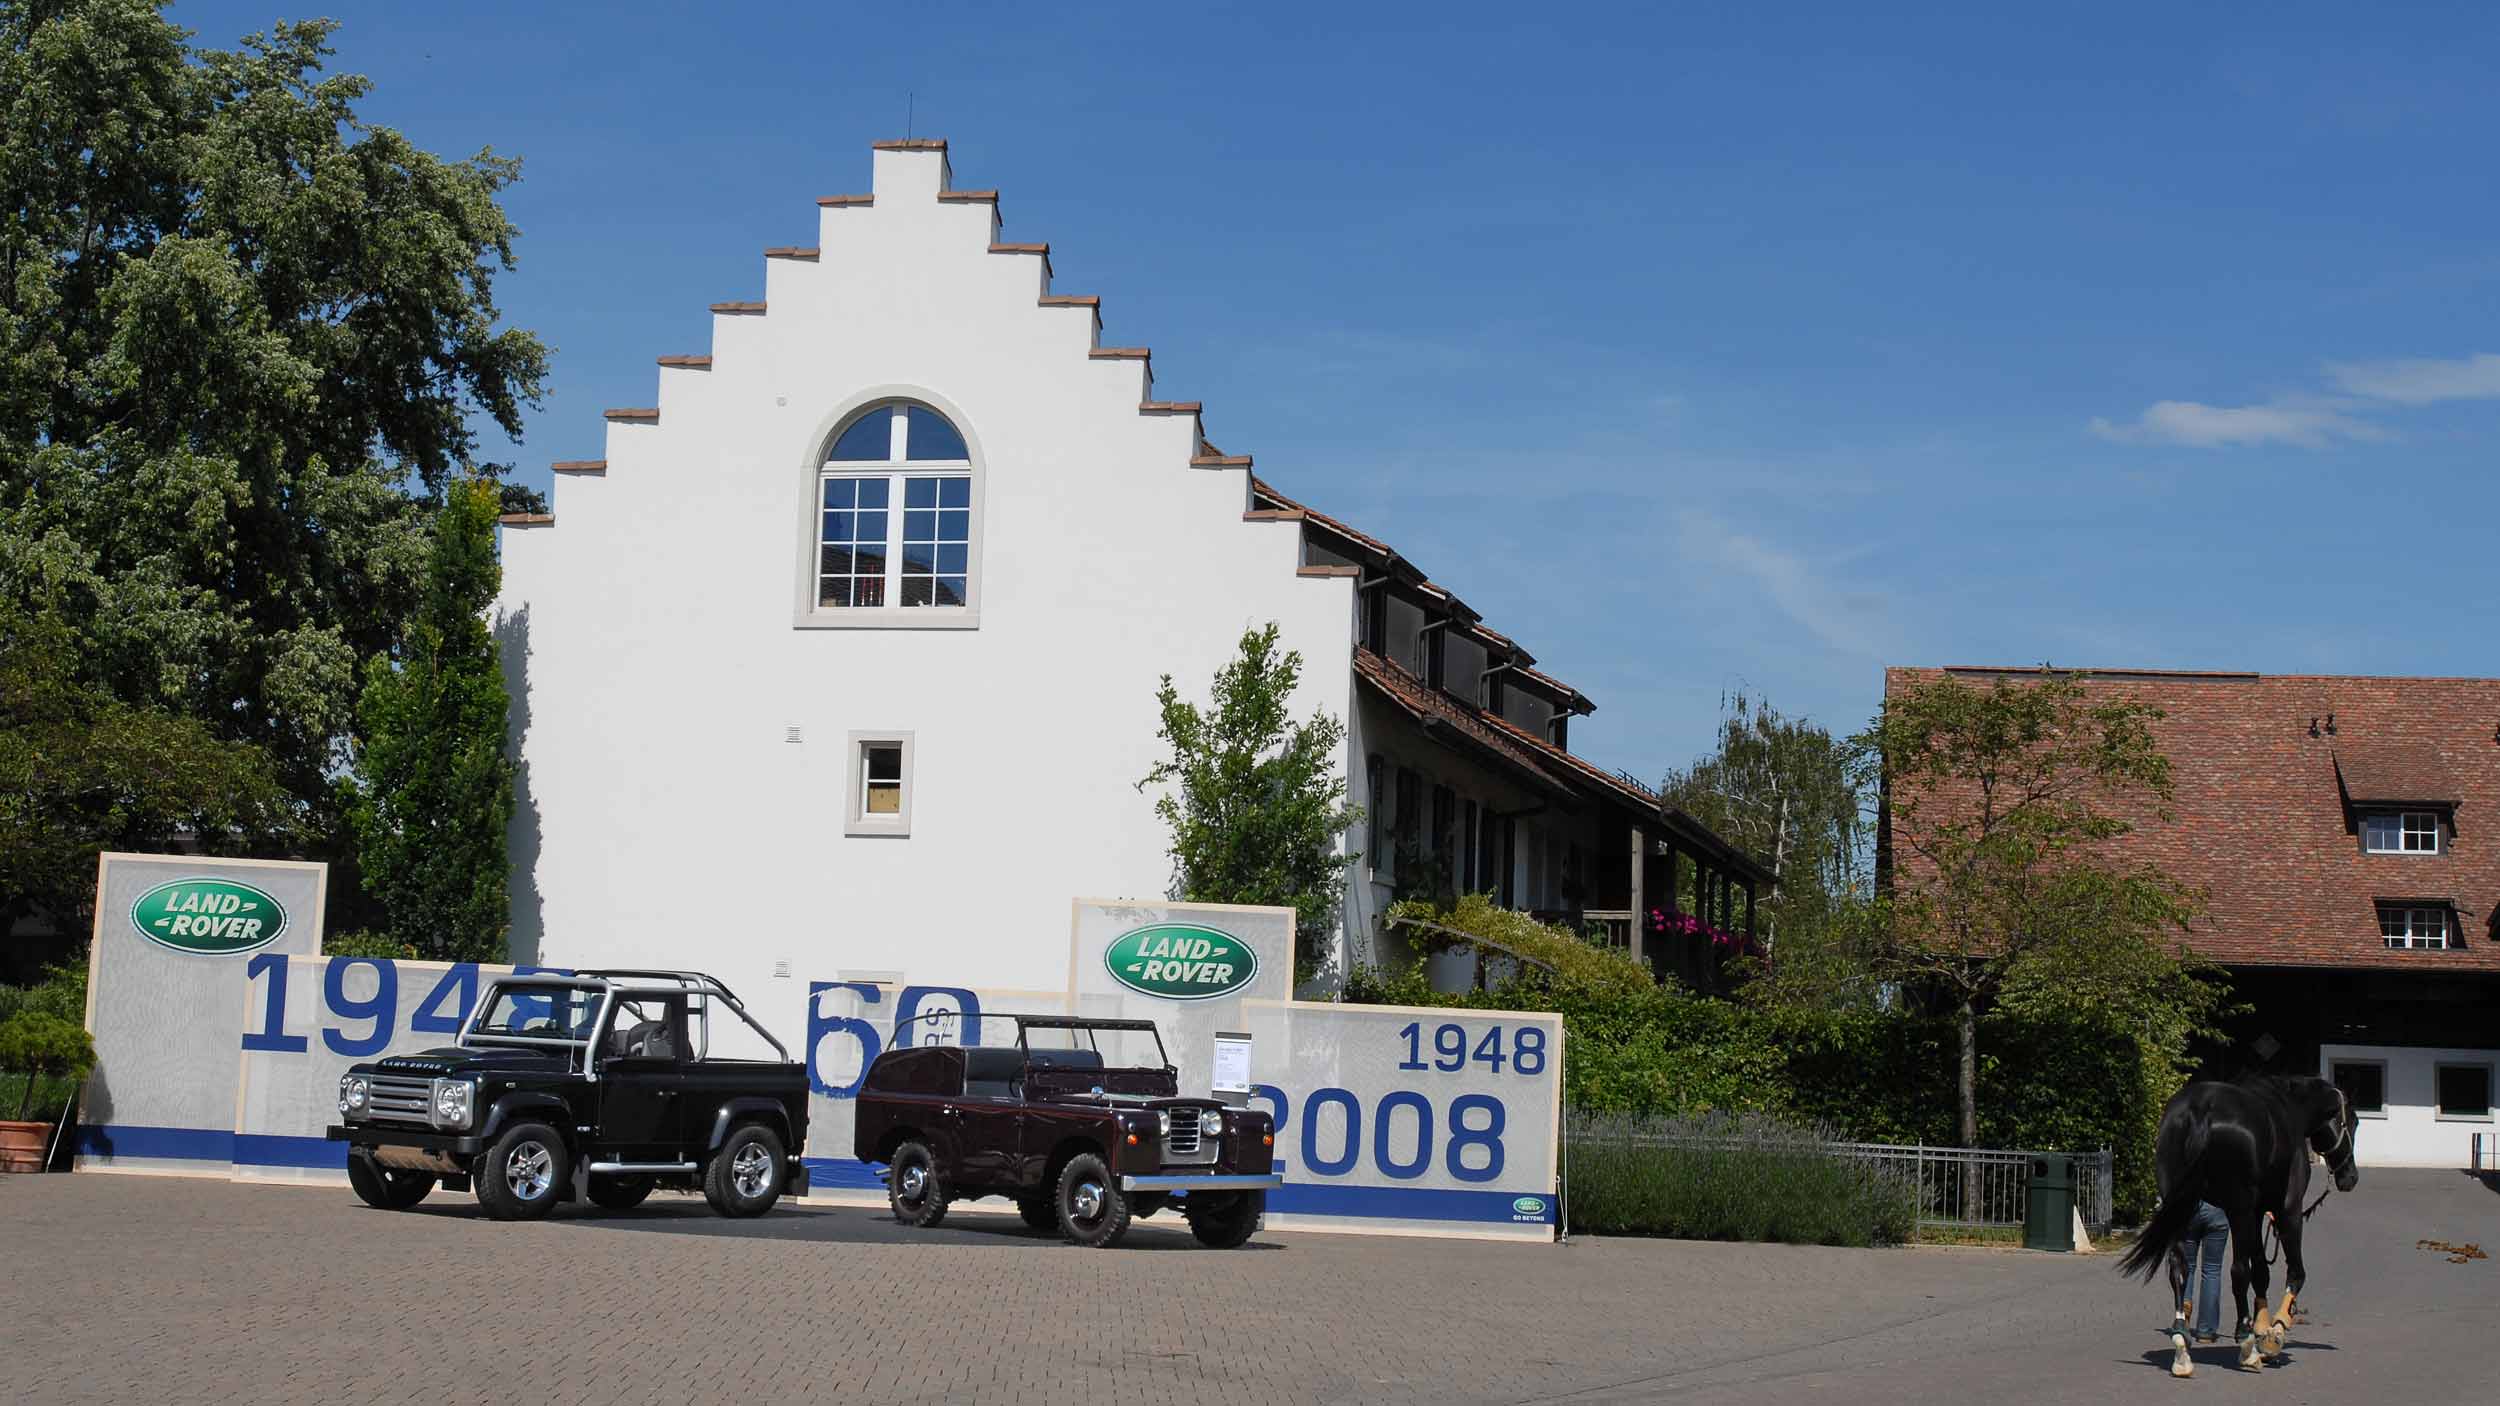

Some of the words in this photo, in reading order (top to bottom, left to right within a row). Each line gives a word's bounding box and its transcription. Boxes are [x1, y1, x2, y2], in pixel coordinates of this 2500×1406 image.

[165, 891, 241, 915] LAND
[170, 915, 263, 939] ROVER
[1136, 936, 1211, 960] LAND
[1142, 959, 1234, 984] ROVER
[1399, 1022, 1546, 1075] 1948
